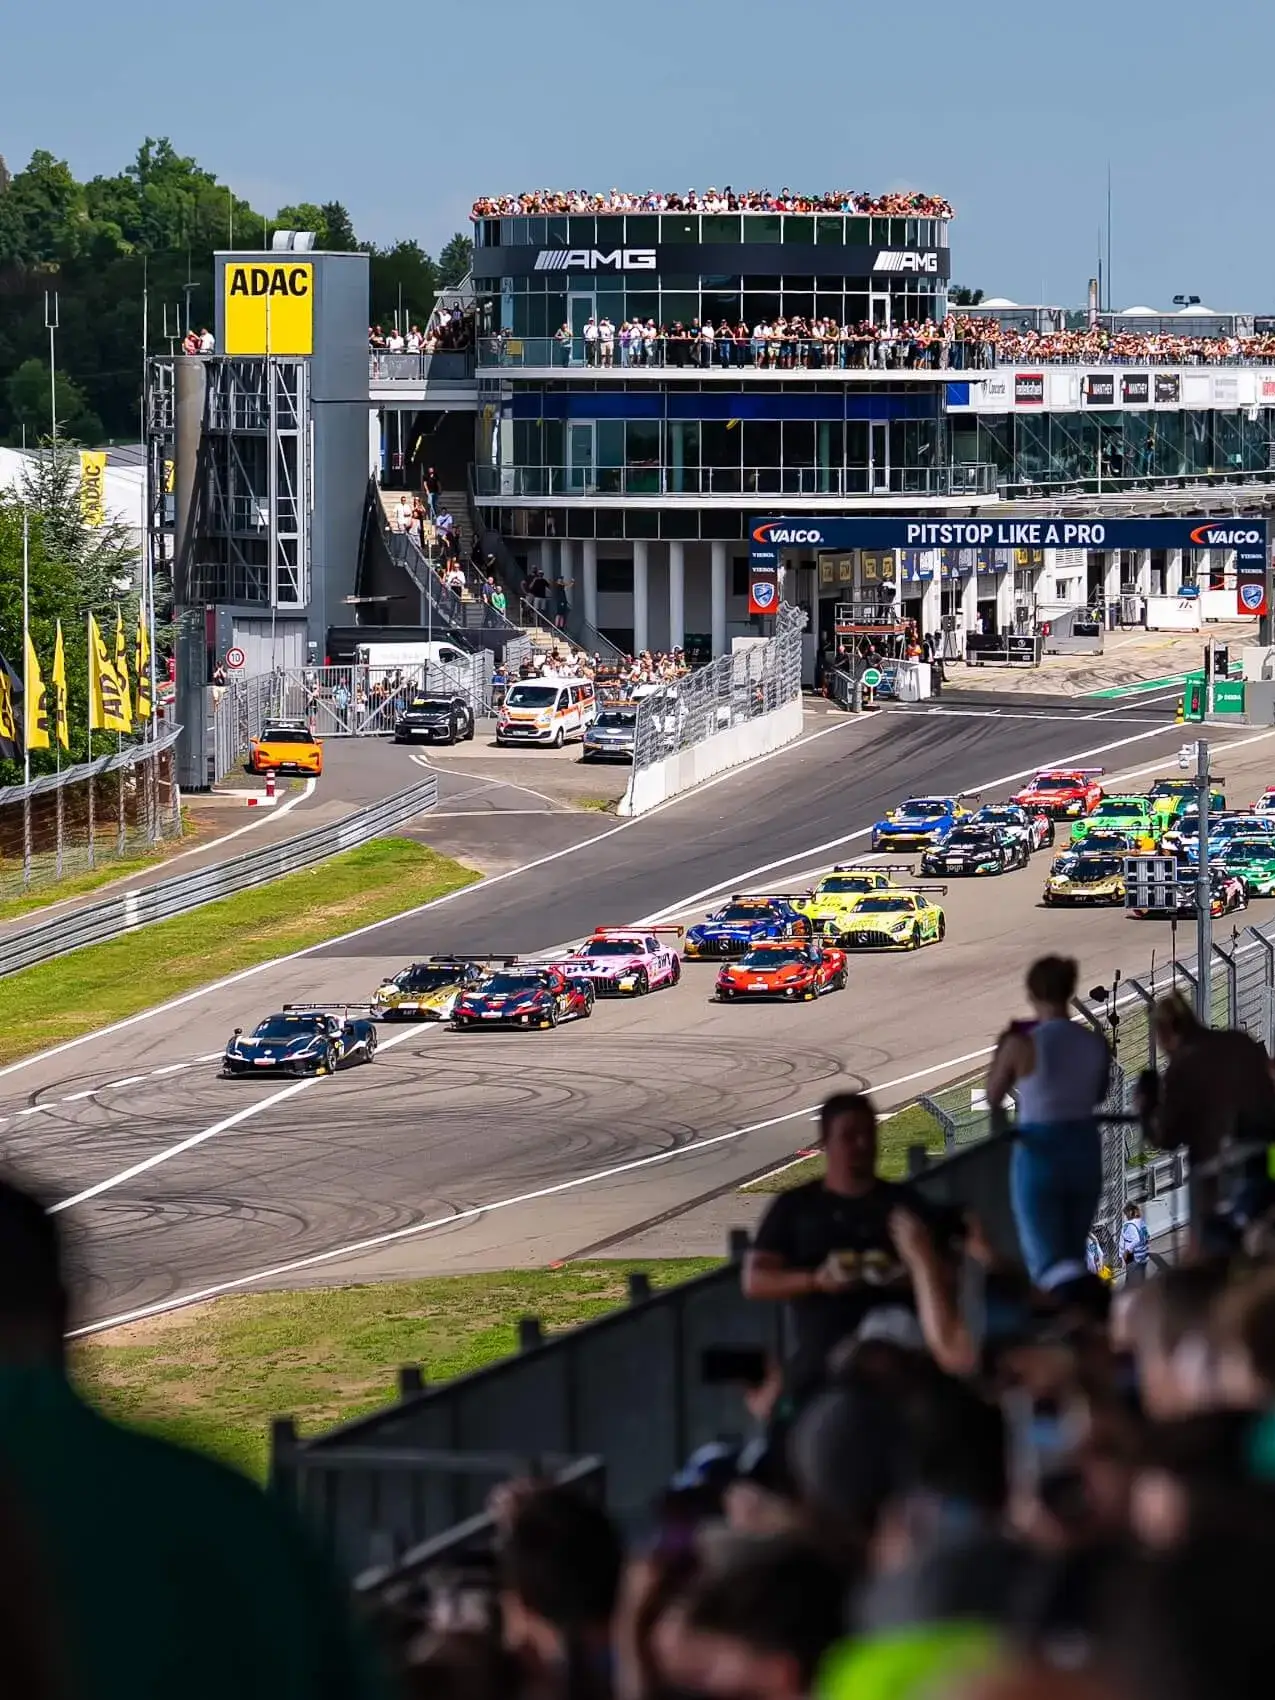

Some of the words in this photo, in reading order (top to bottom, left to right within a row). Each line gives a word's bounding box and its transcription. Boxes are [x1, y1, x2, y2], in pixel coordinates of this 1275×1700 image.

[562, 249, 656, 269] AMG
[899, 251, 937, 272] AMG
[230, 268, 308, 296] ADAC
[769, 529, 821, 543] VAICO
[907, 524, 993, 544] PITSTOP
[998, 524, 1040, 544] LIKE
[1045, 524, 1060, 544] A
[1064, 524, 1105, 544] PRO
[1207, 530, 1260, 544] VAICO
[231, 652, 241, 662] 10
